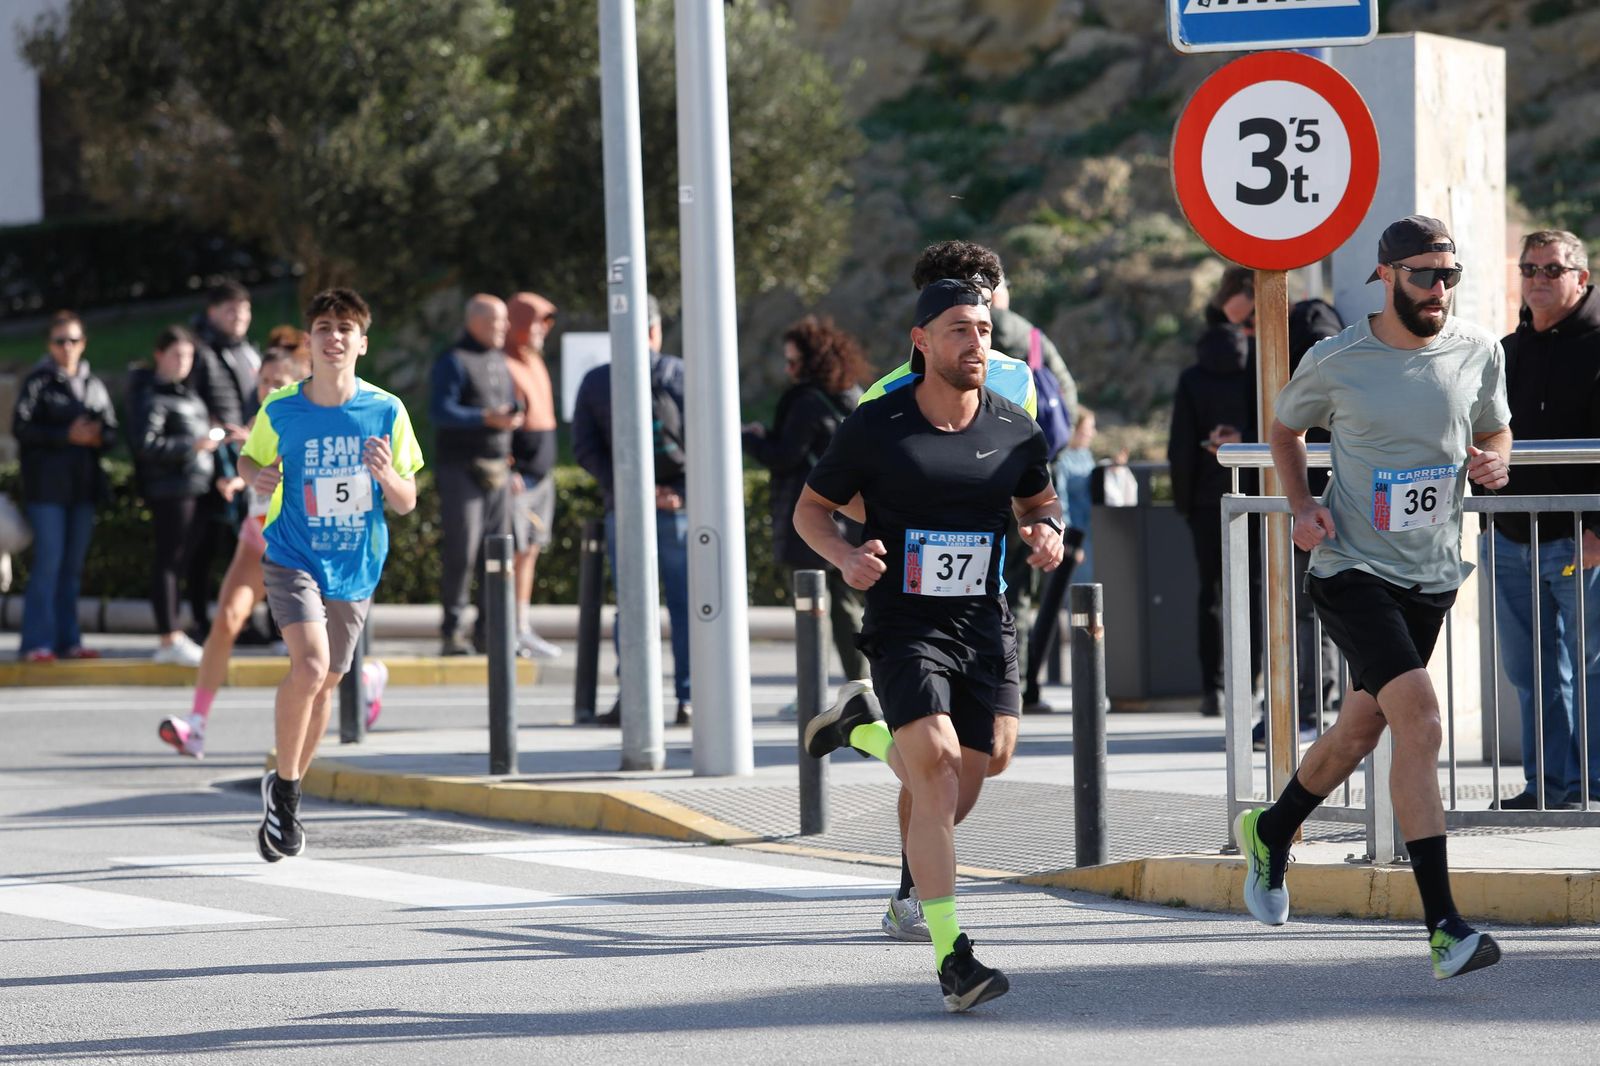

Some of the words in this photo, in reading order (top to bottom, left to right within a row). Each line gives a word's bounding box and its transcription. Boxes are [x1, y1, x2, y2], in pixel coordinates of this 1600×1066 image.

[323, 436, 360, 455] SAN
[1397, 467, 1454, 480] CARRERA
[336, 483, 349, 503] 5
[1404, 486, 1437, 515] 36
[929, 534, 990, 542] CARRERA
[907, 543, 920, 554] SAN
[936, 553, 973, 581] 37
